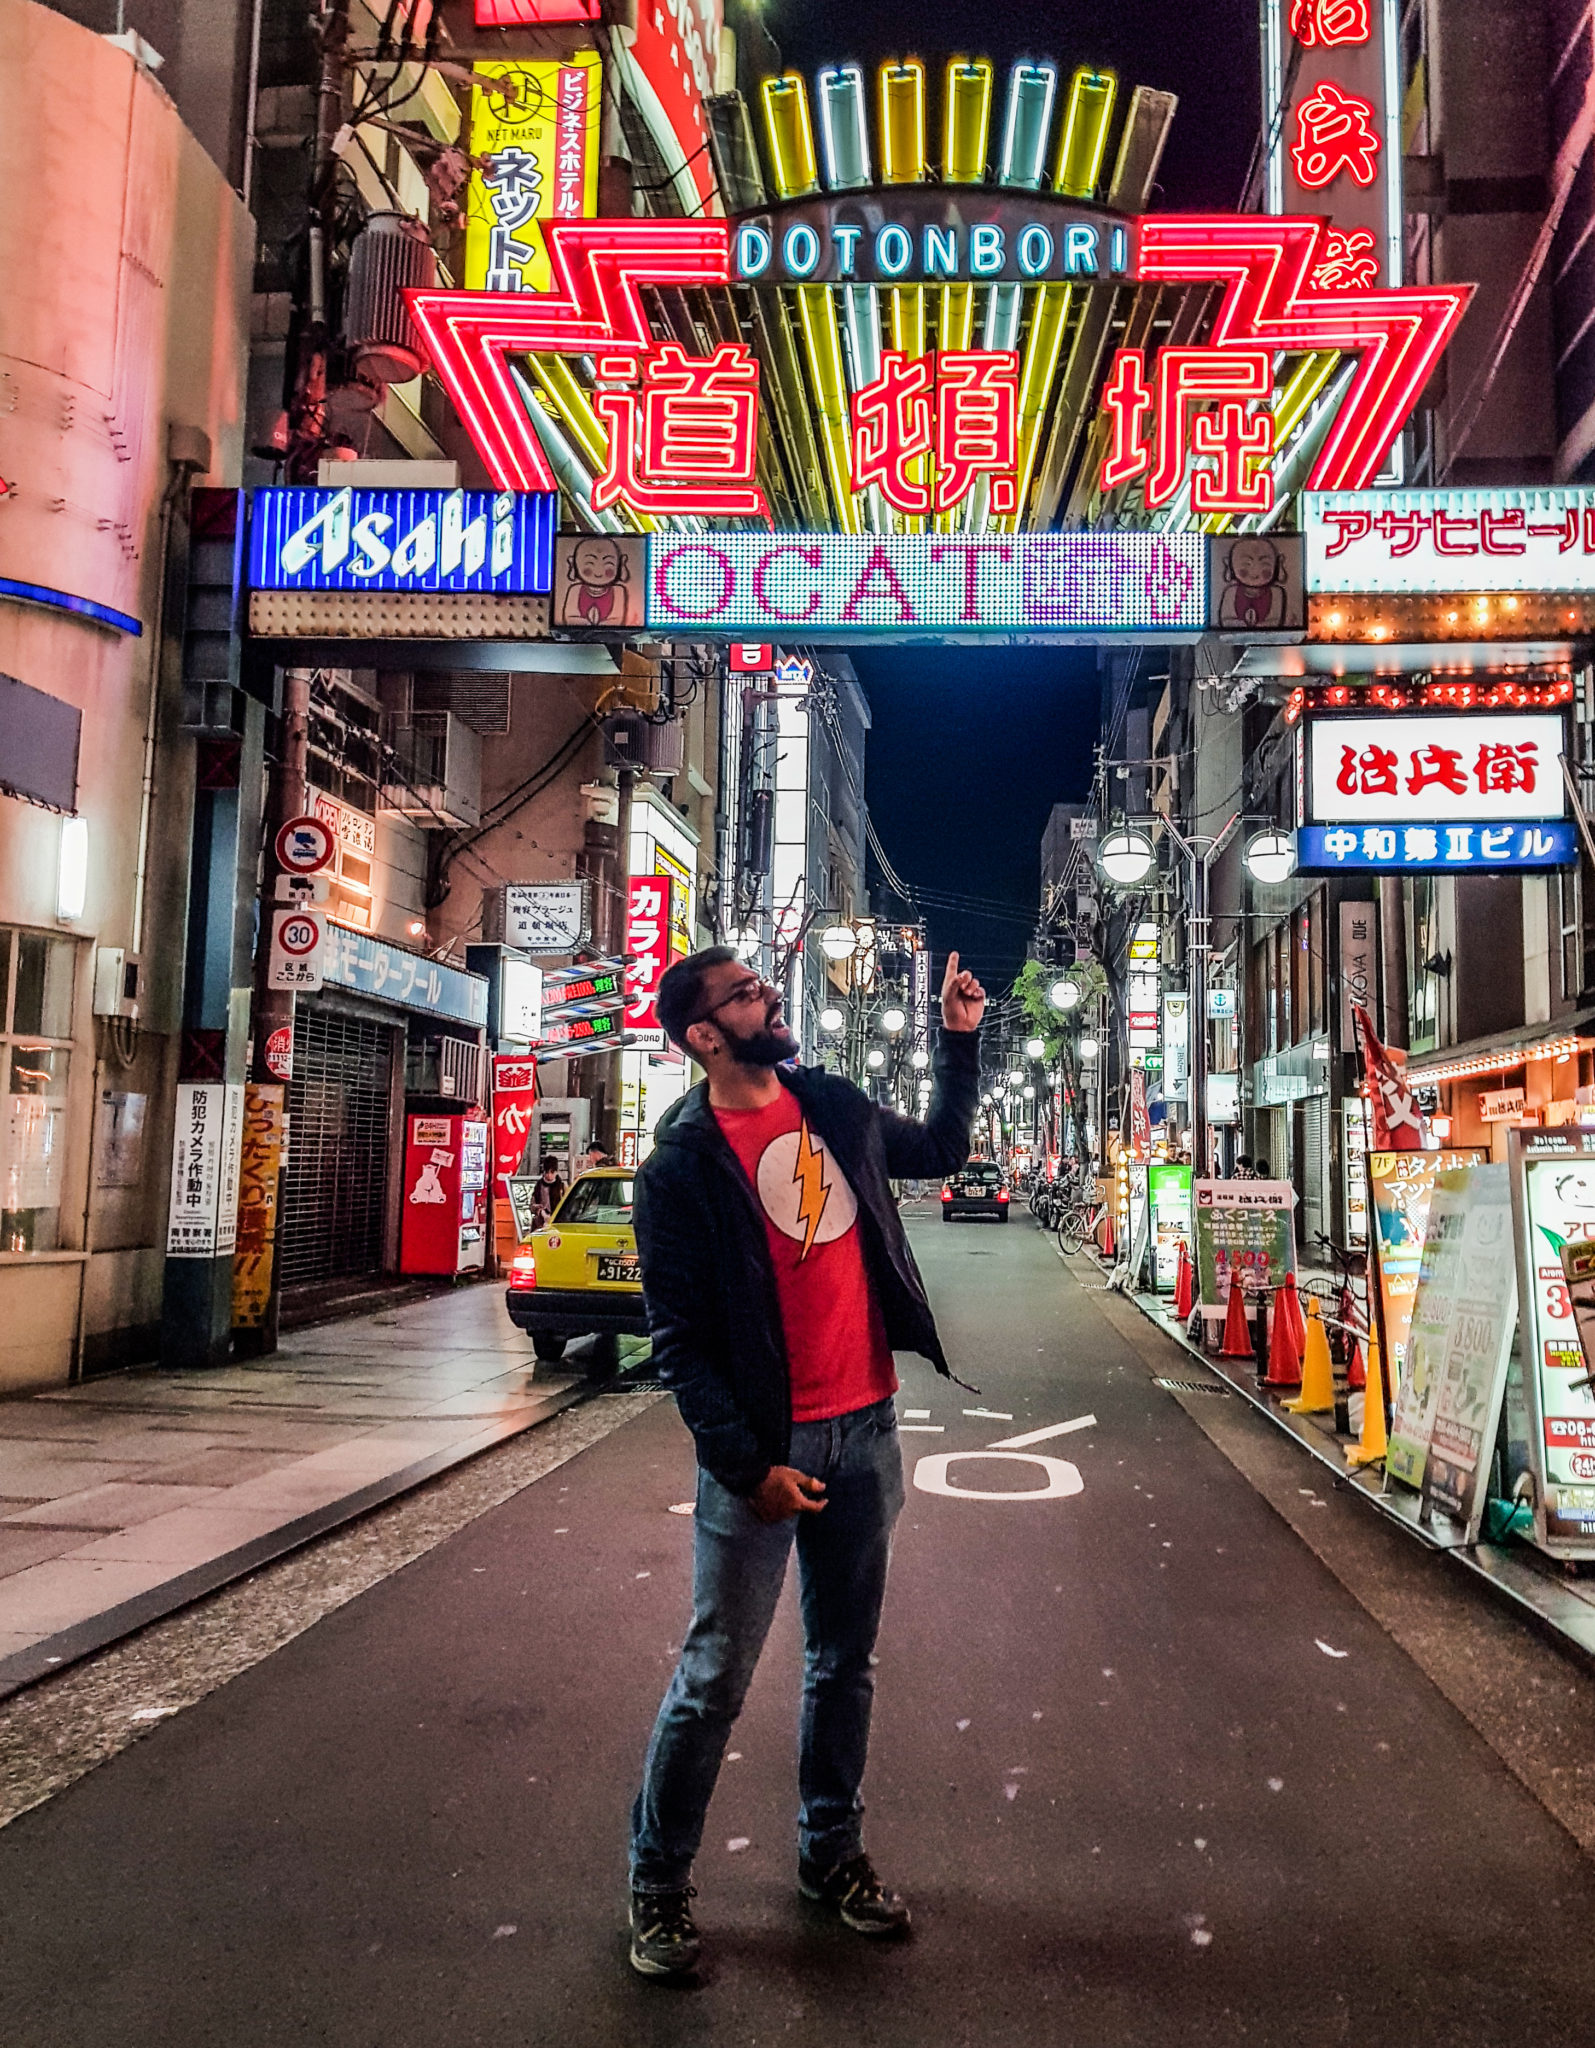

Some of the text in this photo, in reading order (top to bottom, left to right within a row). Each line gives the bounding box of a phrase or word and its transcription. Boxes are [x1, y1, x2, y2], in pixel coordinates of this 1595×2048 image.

[486, 127, 543, 141] NET MARU
[558, 71, 586, 219] ビジネスホテル
[737, 223, 1129, 277] DOTONBORI
[594, 341, 1276, 516] 道頓堀
[280, 486, 517, 578] Asahi
[1322, 508, 1595, 559] アサヒビール
[654, 543, 1012, 624] OCAT
[1336, 741, 1540, 796] 治兵衛
[287, 925, 310, 944] 30
[626, 885, 662, 1019] カラオケ
[276, 972, 315, 982] ここから
[186, 1090, 208, 1208] 防犯カメラ作動中
[1374, 1156, 1390, 1169] 7F
